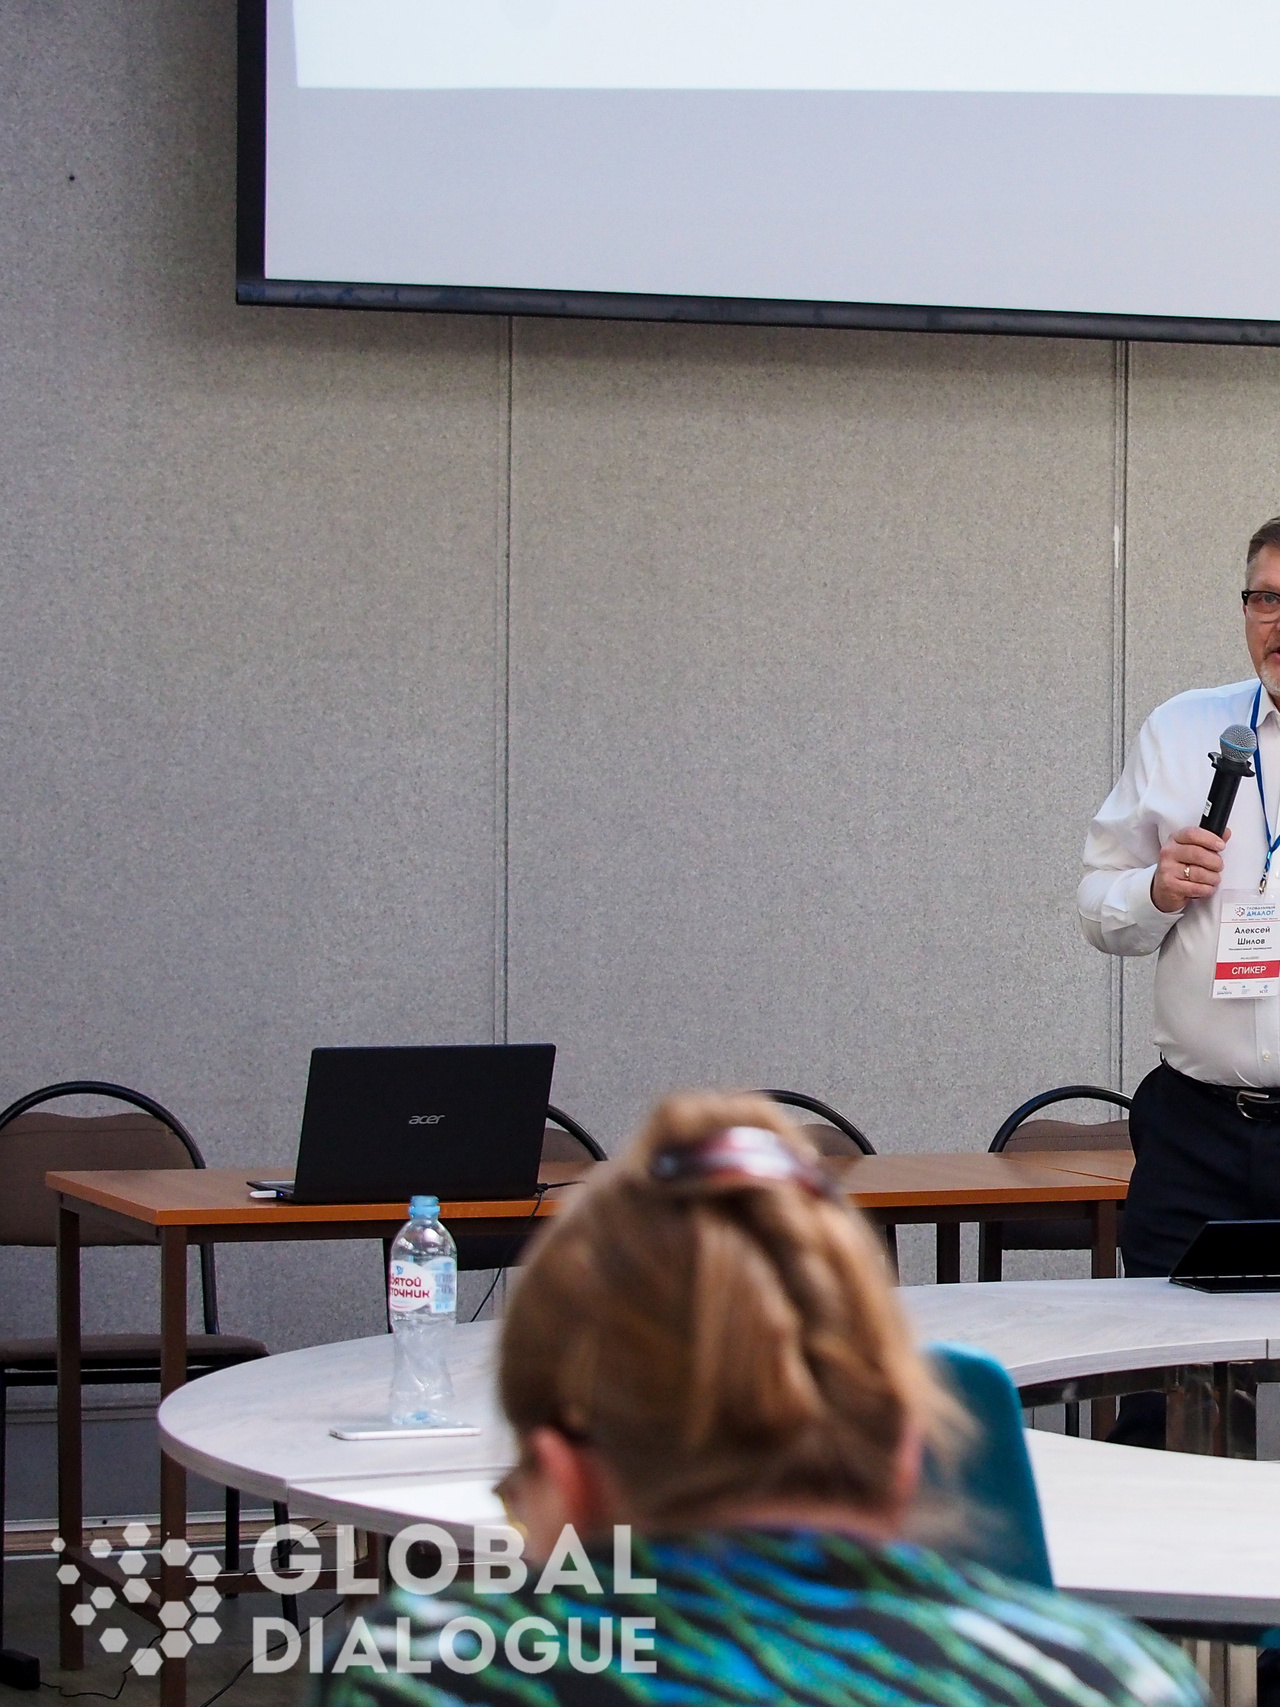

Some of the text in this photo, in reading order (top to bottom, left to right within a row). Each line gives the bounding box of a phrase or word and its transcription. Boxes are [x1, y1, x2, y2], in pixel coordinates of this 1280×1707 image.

[1234, 926, 1271, 935] Алексей
[1231, 965, 1267, 975] СПИКЕР
[408, 1114, 445, 1125] acer
